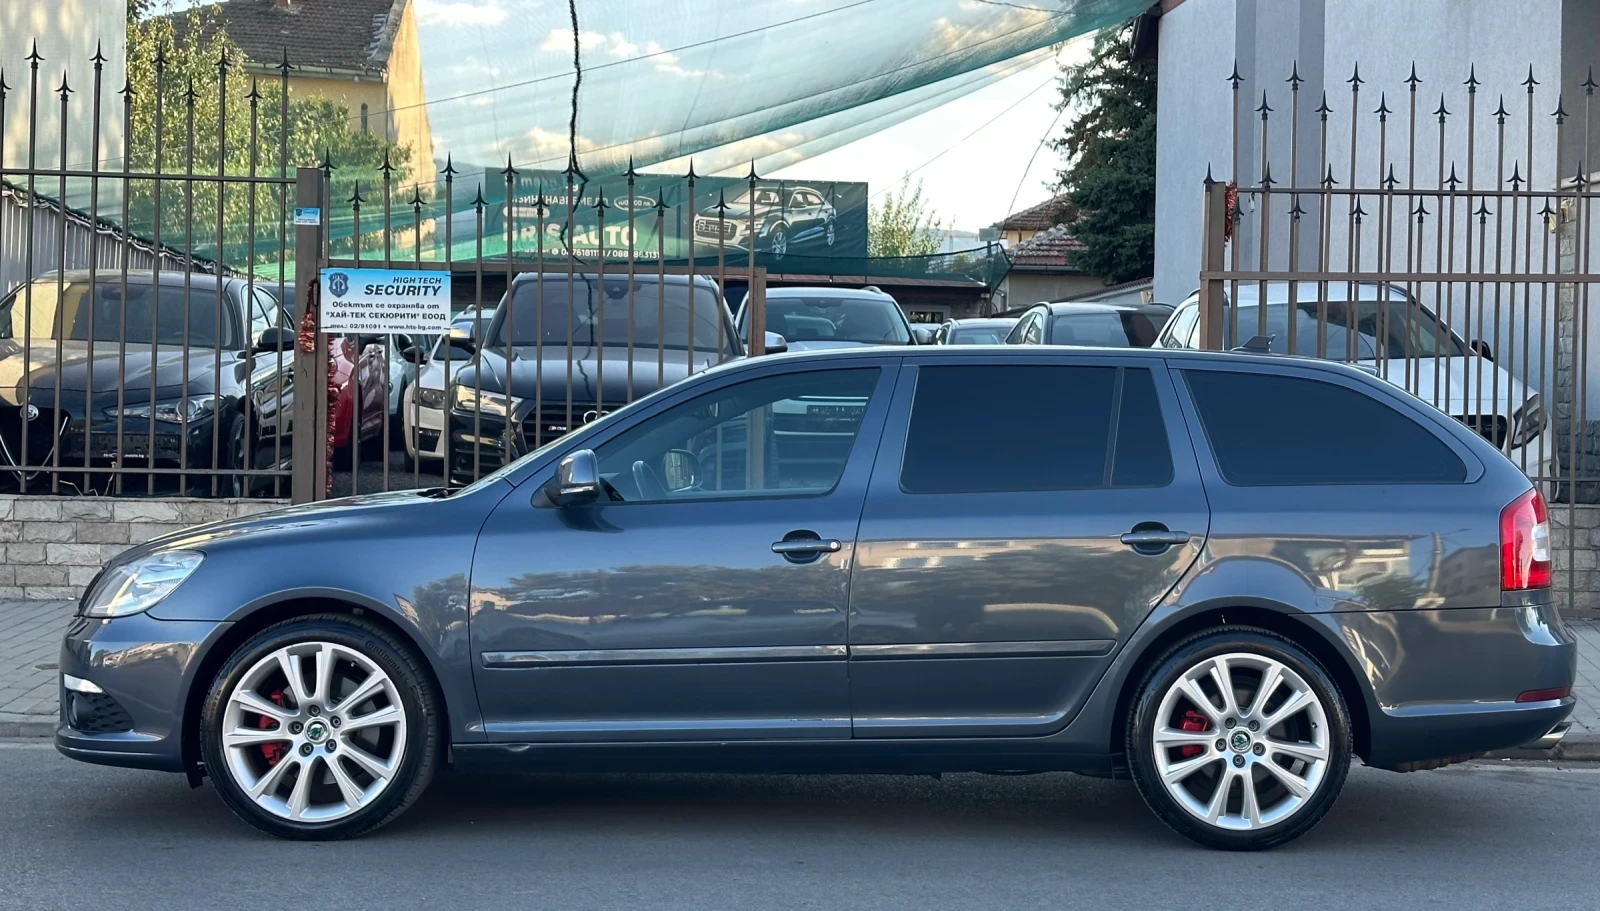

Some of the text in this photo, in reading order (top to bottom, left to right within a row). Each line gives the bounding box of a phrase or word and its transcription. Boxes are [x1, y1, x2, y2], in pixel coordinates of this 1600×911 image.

[572, 225, 638, 246] AUTO
[364, 285, 442, 296] SECURITY
[332, 301, 373, 309] Обектът
[387, 302, 425, 310] охранява
